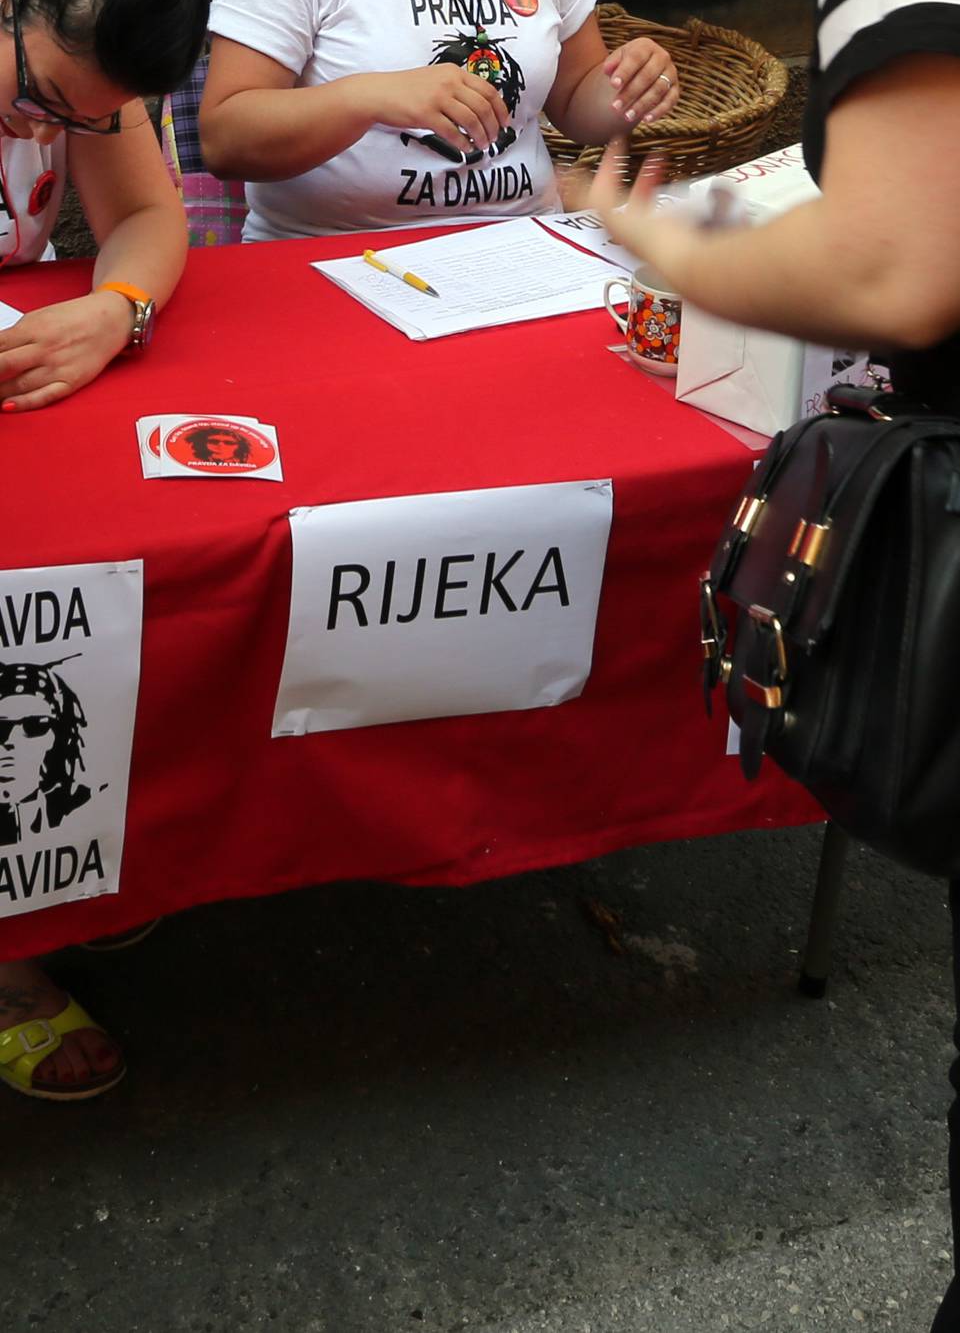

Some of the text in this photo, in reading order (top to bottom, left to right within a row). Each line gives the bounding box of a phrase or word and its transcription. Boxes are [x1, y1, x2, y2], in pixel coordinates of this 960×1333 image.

[396, 162, 534, 208] ZA DAVIDA
[326, 546, 571, 630] RIJEKA
